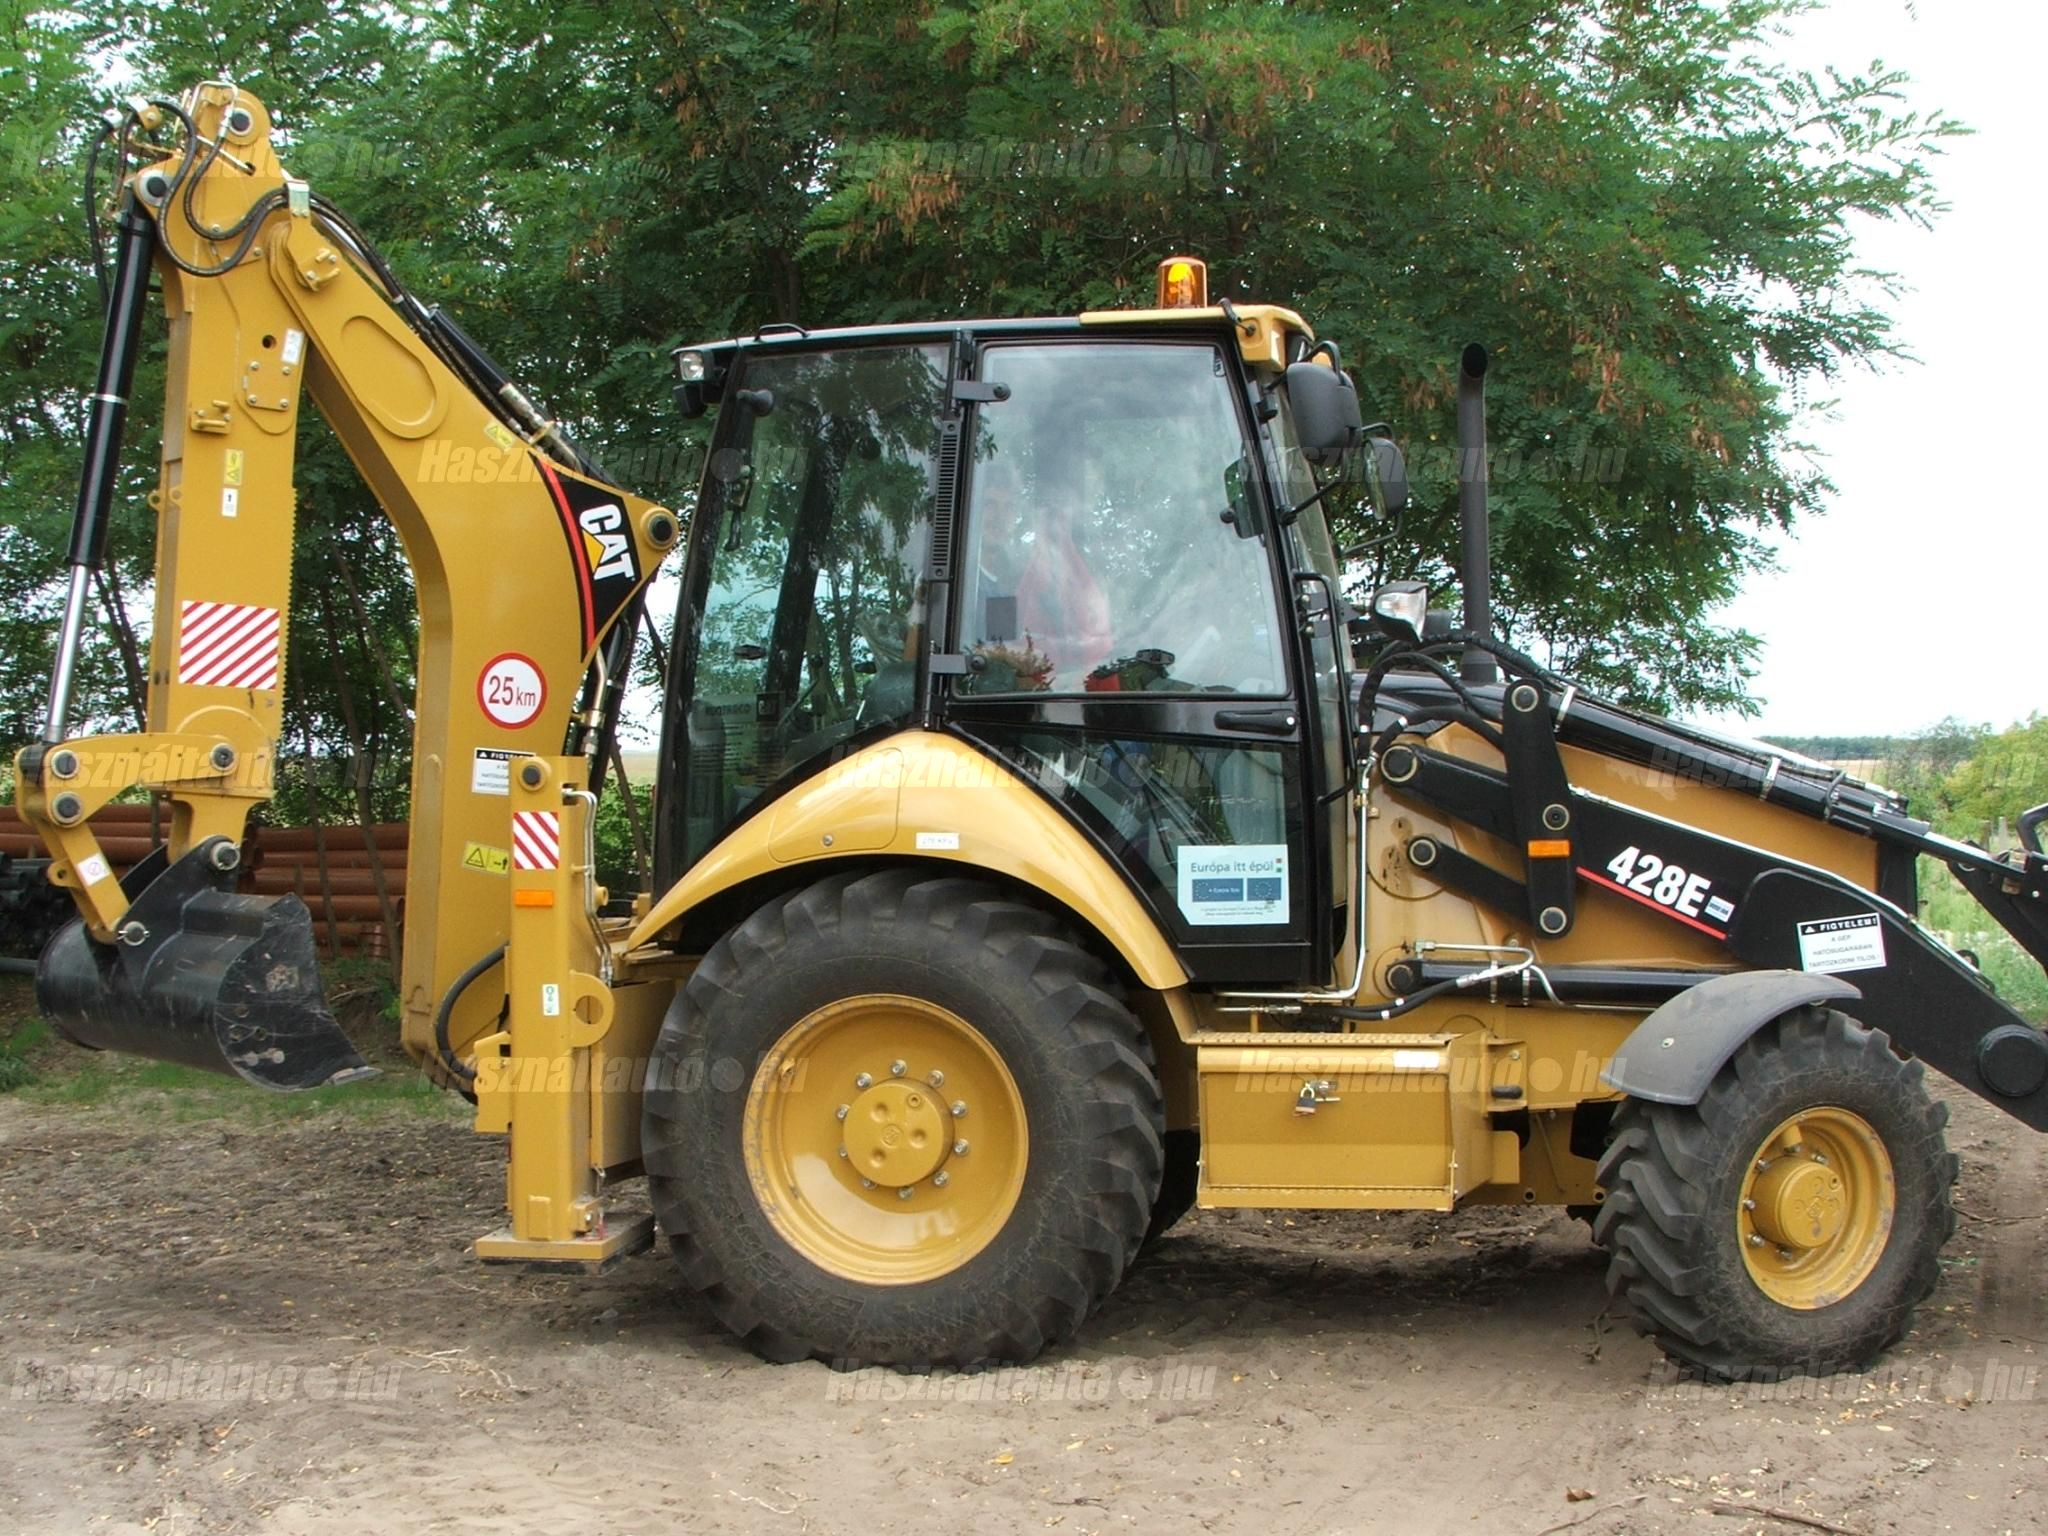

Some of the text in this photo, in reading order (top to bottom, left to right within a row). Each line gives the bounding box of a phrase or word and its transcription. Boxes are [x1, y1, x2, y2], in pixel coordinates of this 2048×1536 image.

[579, 503, 635, 581] CAT
[488, 675, 536, 706] 25 km
[1190, 861, 1274, 874] Európa itt épül
[1607, 846, 1712, 918] 428E
